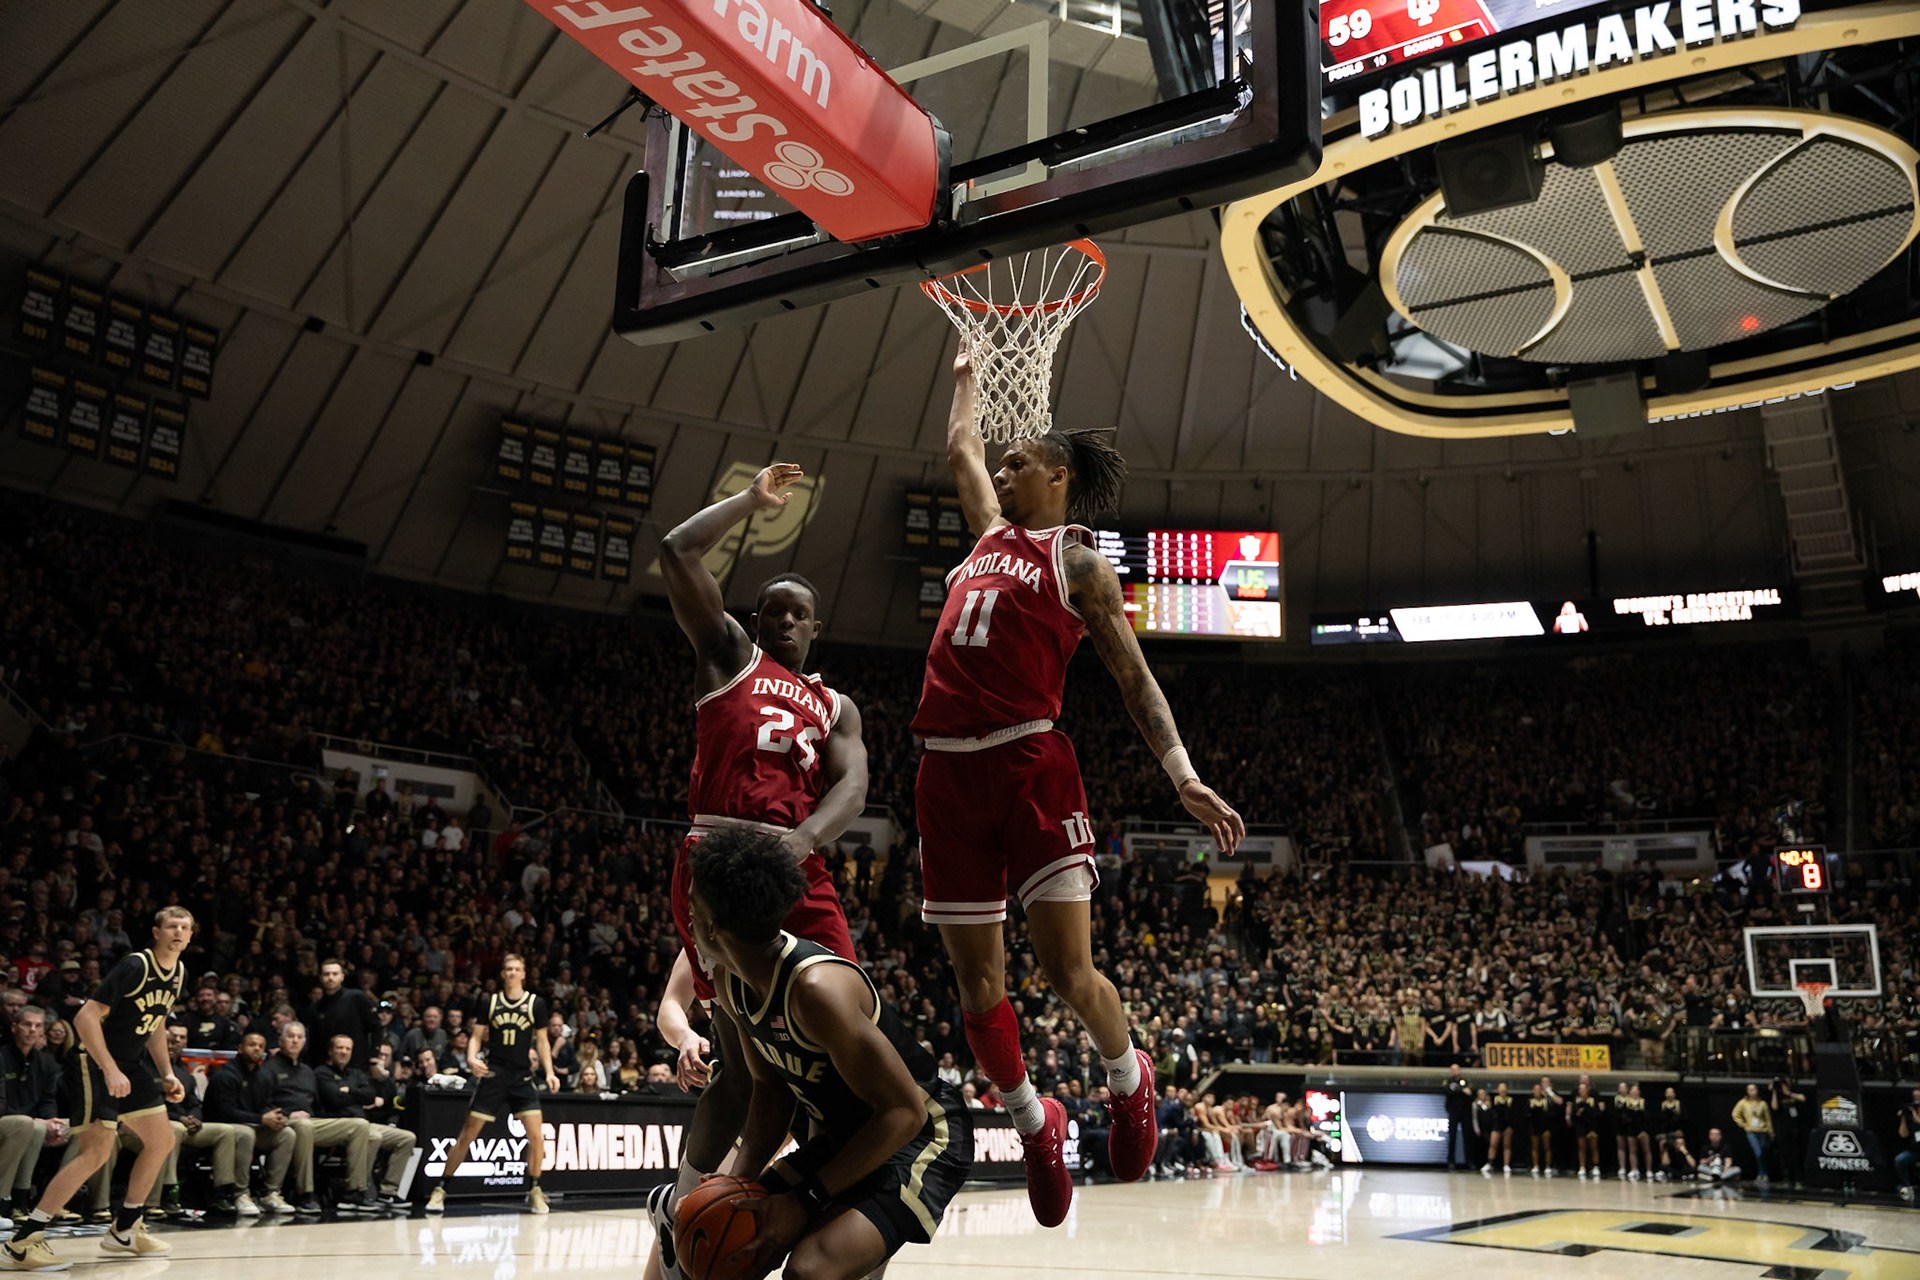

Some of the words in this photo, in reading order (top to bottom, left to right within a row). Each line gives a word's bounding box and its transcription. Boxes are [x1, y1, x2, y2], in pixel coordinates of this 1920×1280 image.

[1328, 9, 1372, 46] 59
[713, 0, 831, 109] arm
[1373, 54, 1387, 68] 10
[552, 0, 788, 142] StateF
[1359, 0, 1800, 138] BOILERMAKERS
[954, 552, 1042, 594] INDIANA
[951, 589, 999, 647] 11
[1779, 850, 1814, 866] 40.4
[1802, 863, 1822, 888] 8
[135, 989, 177, 1013] PURDU
[135, 1014, 164, 1035] 34
[502, 1029, 517, 1046] 11
[1489, 1047, 1556, 1068] DEFENSE
[428, 1138, 528, 1161] XWAY
[541, 1123, 684, 1171] GAMEDAY
[494, 1161, 526, 1176] LFR
